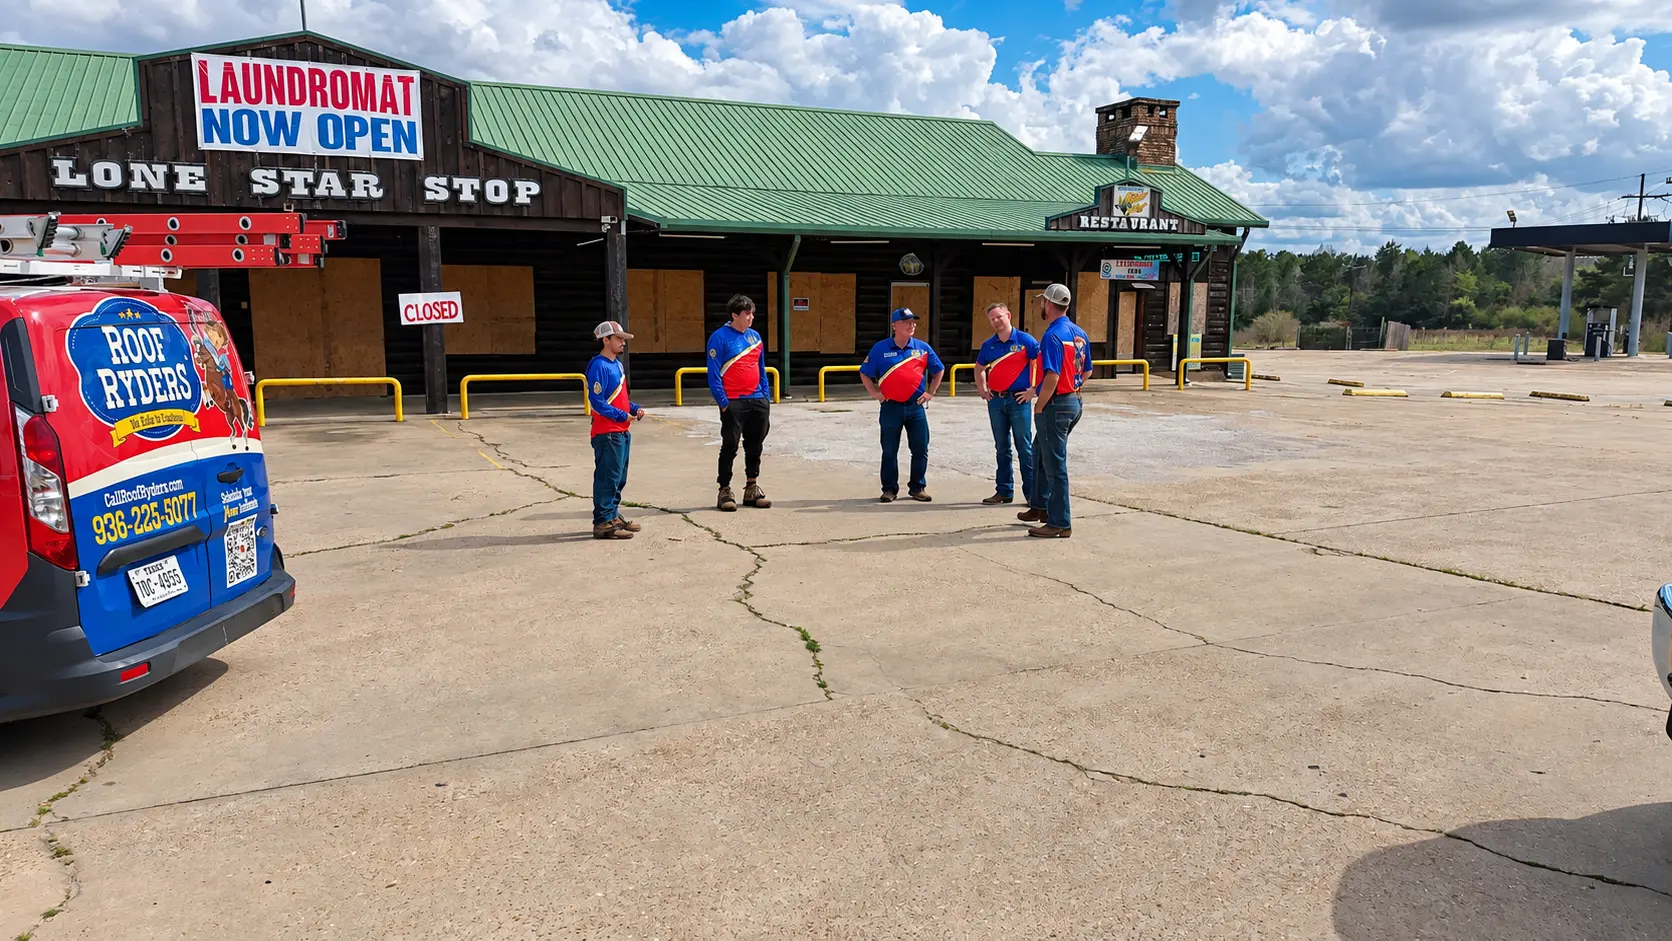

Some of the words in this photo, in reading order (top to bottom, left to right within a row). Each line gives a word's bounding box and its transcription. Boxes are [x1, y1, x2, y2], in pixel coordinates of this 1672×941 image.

[198, 59, 414, 116] LAUNDROMAT
[202, 108, 302, 147] NOW
[317, 113, 418, 154] OPEN
[52, 159, 206, 191] LONE
[250, 169, 383, 198] STAR
[424, 176, 540, 204] STOP
[1079, 215, 1179, 231] RESTAURANT
[404, 300, 459, 322] CLOSED
[101, 325, 166, 364] ROOF
[97, 362, 192, 409] RYDERS
[92, 491, 197, 545] 936-225-5077
